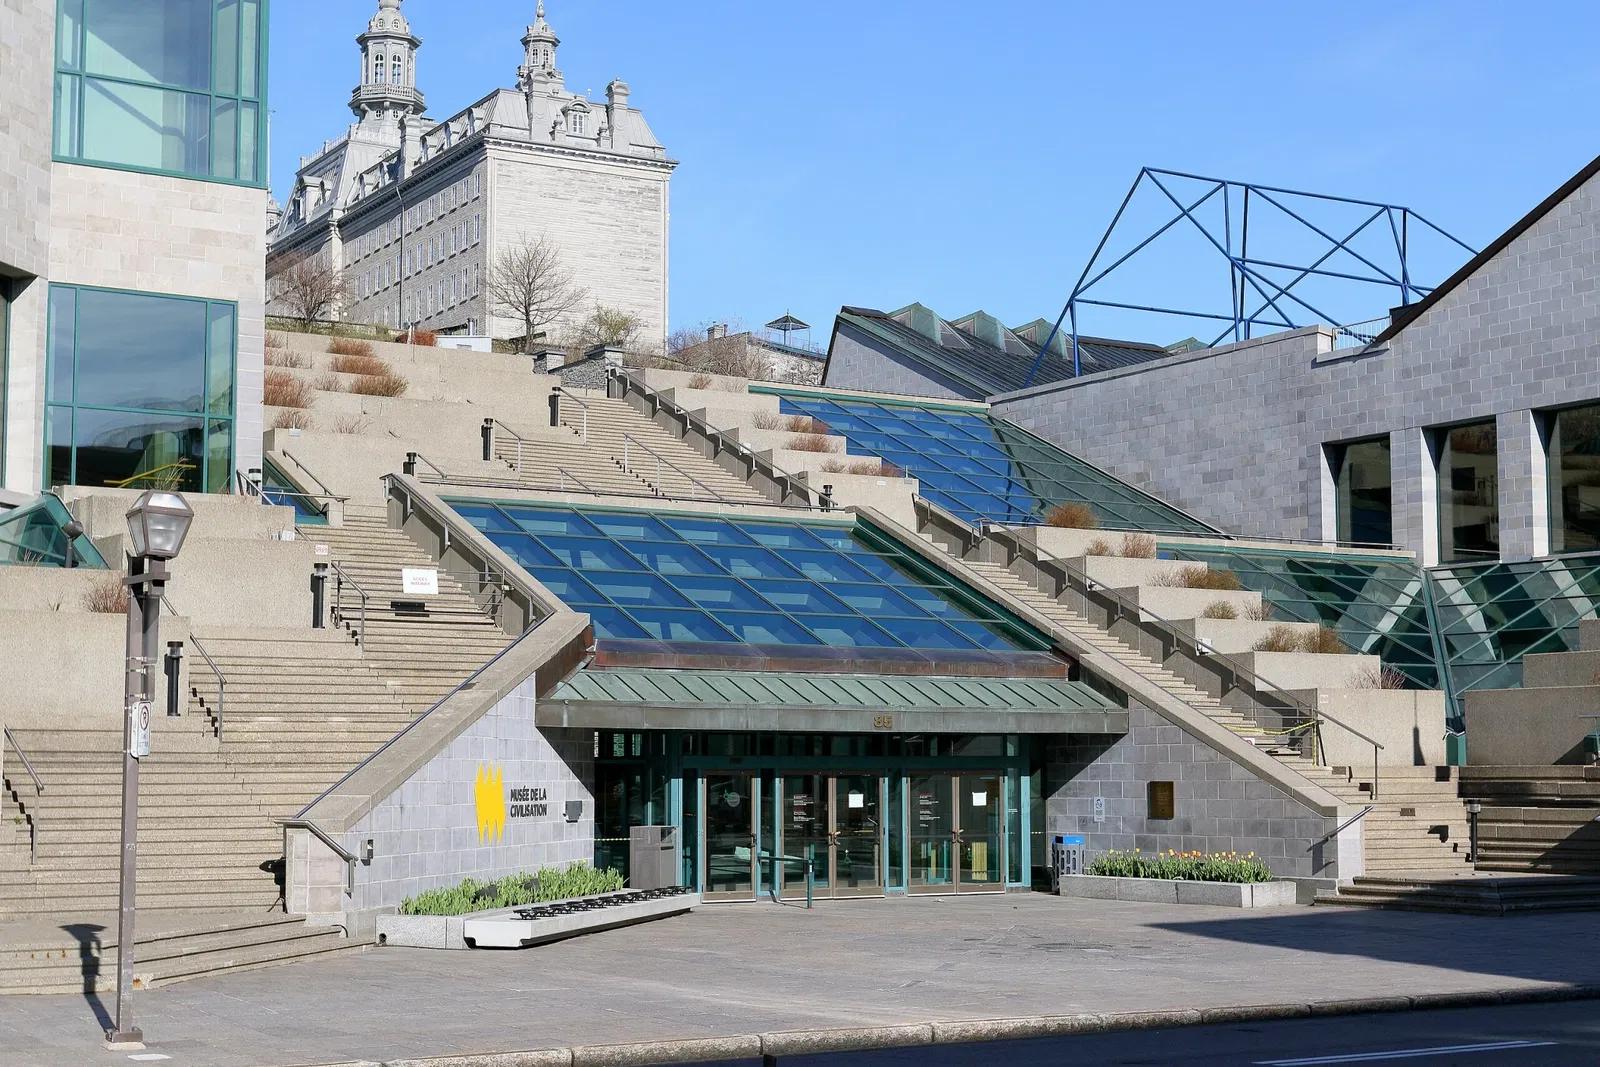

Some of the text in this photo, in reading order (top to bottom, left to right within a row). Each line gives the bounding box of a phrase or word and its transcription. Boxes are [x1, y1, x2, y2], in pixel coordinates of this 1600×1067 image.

[873, 715, 892, 728] 85
[510, 785, 547, 802] MUSÉE DE LA
[510, 804, 547, 818] CIVILISATION
